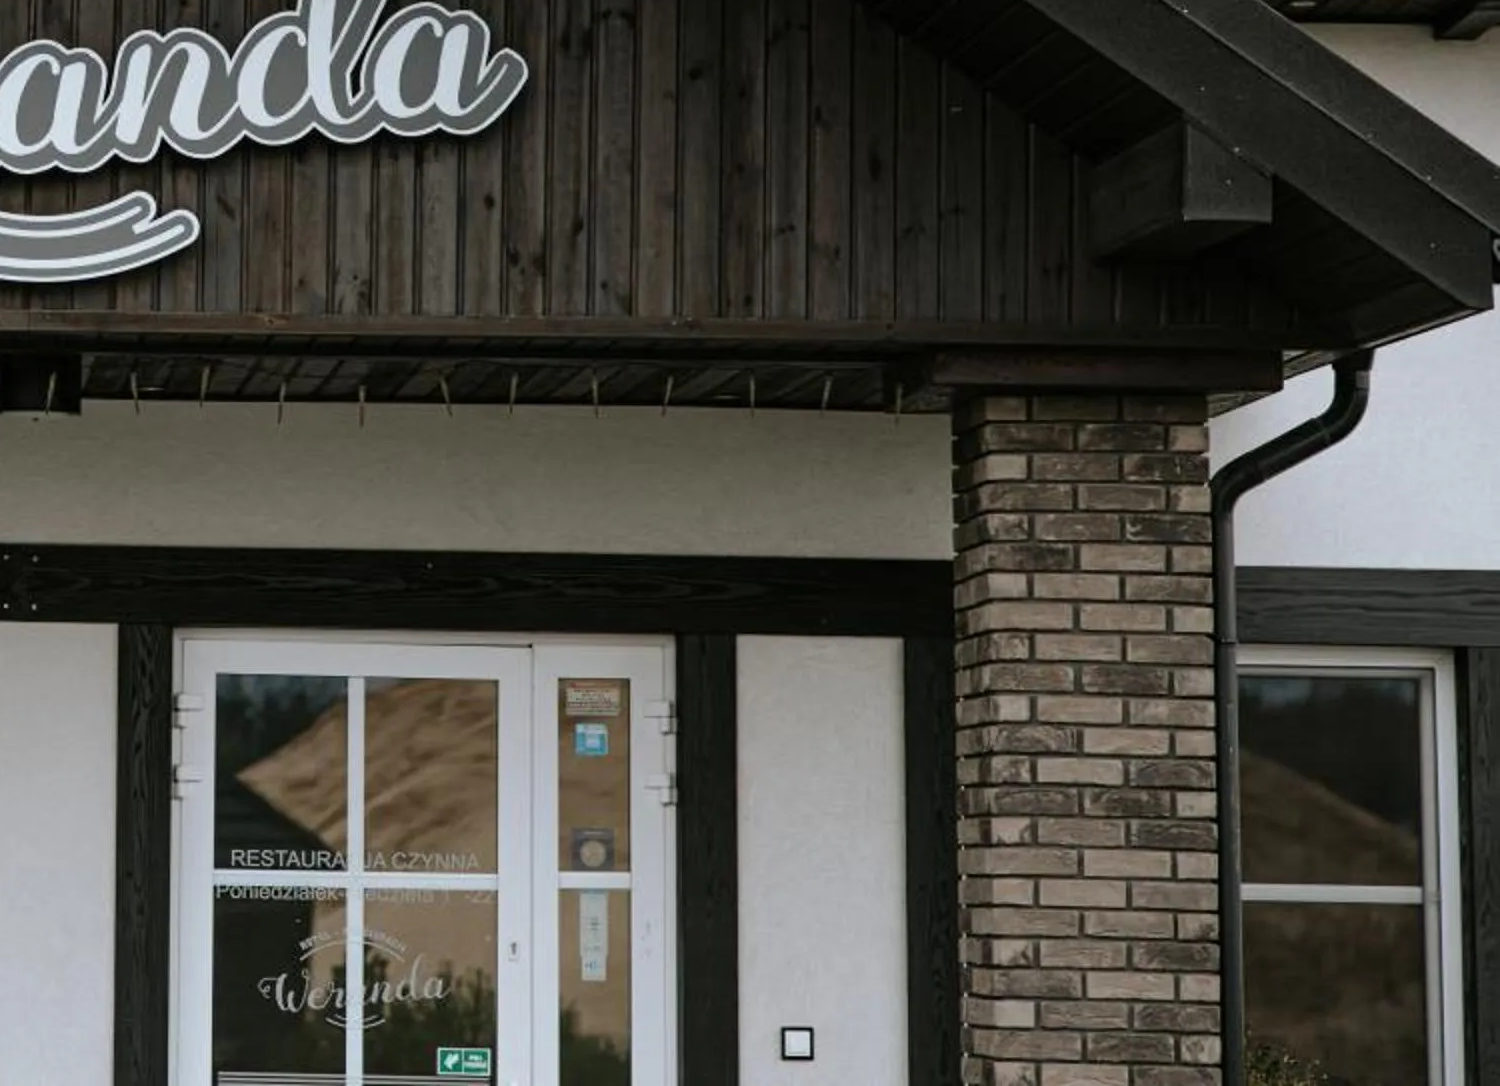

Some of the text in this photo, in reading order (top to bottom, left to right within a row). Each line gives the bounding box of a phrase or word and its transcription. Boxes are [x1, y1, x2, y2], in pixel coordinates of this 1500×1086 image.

[231, 849, 480, 871] RESTAURAJA CZYNNA
[257, 954, 451, 1013] Wernda
